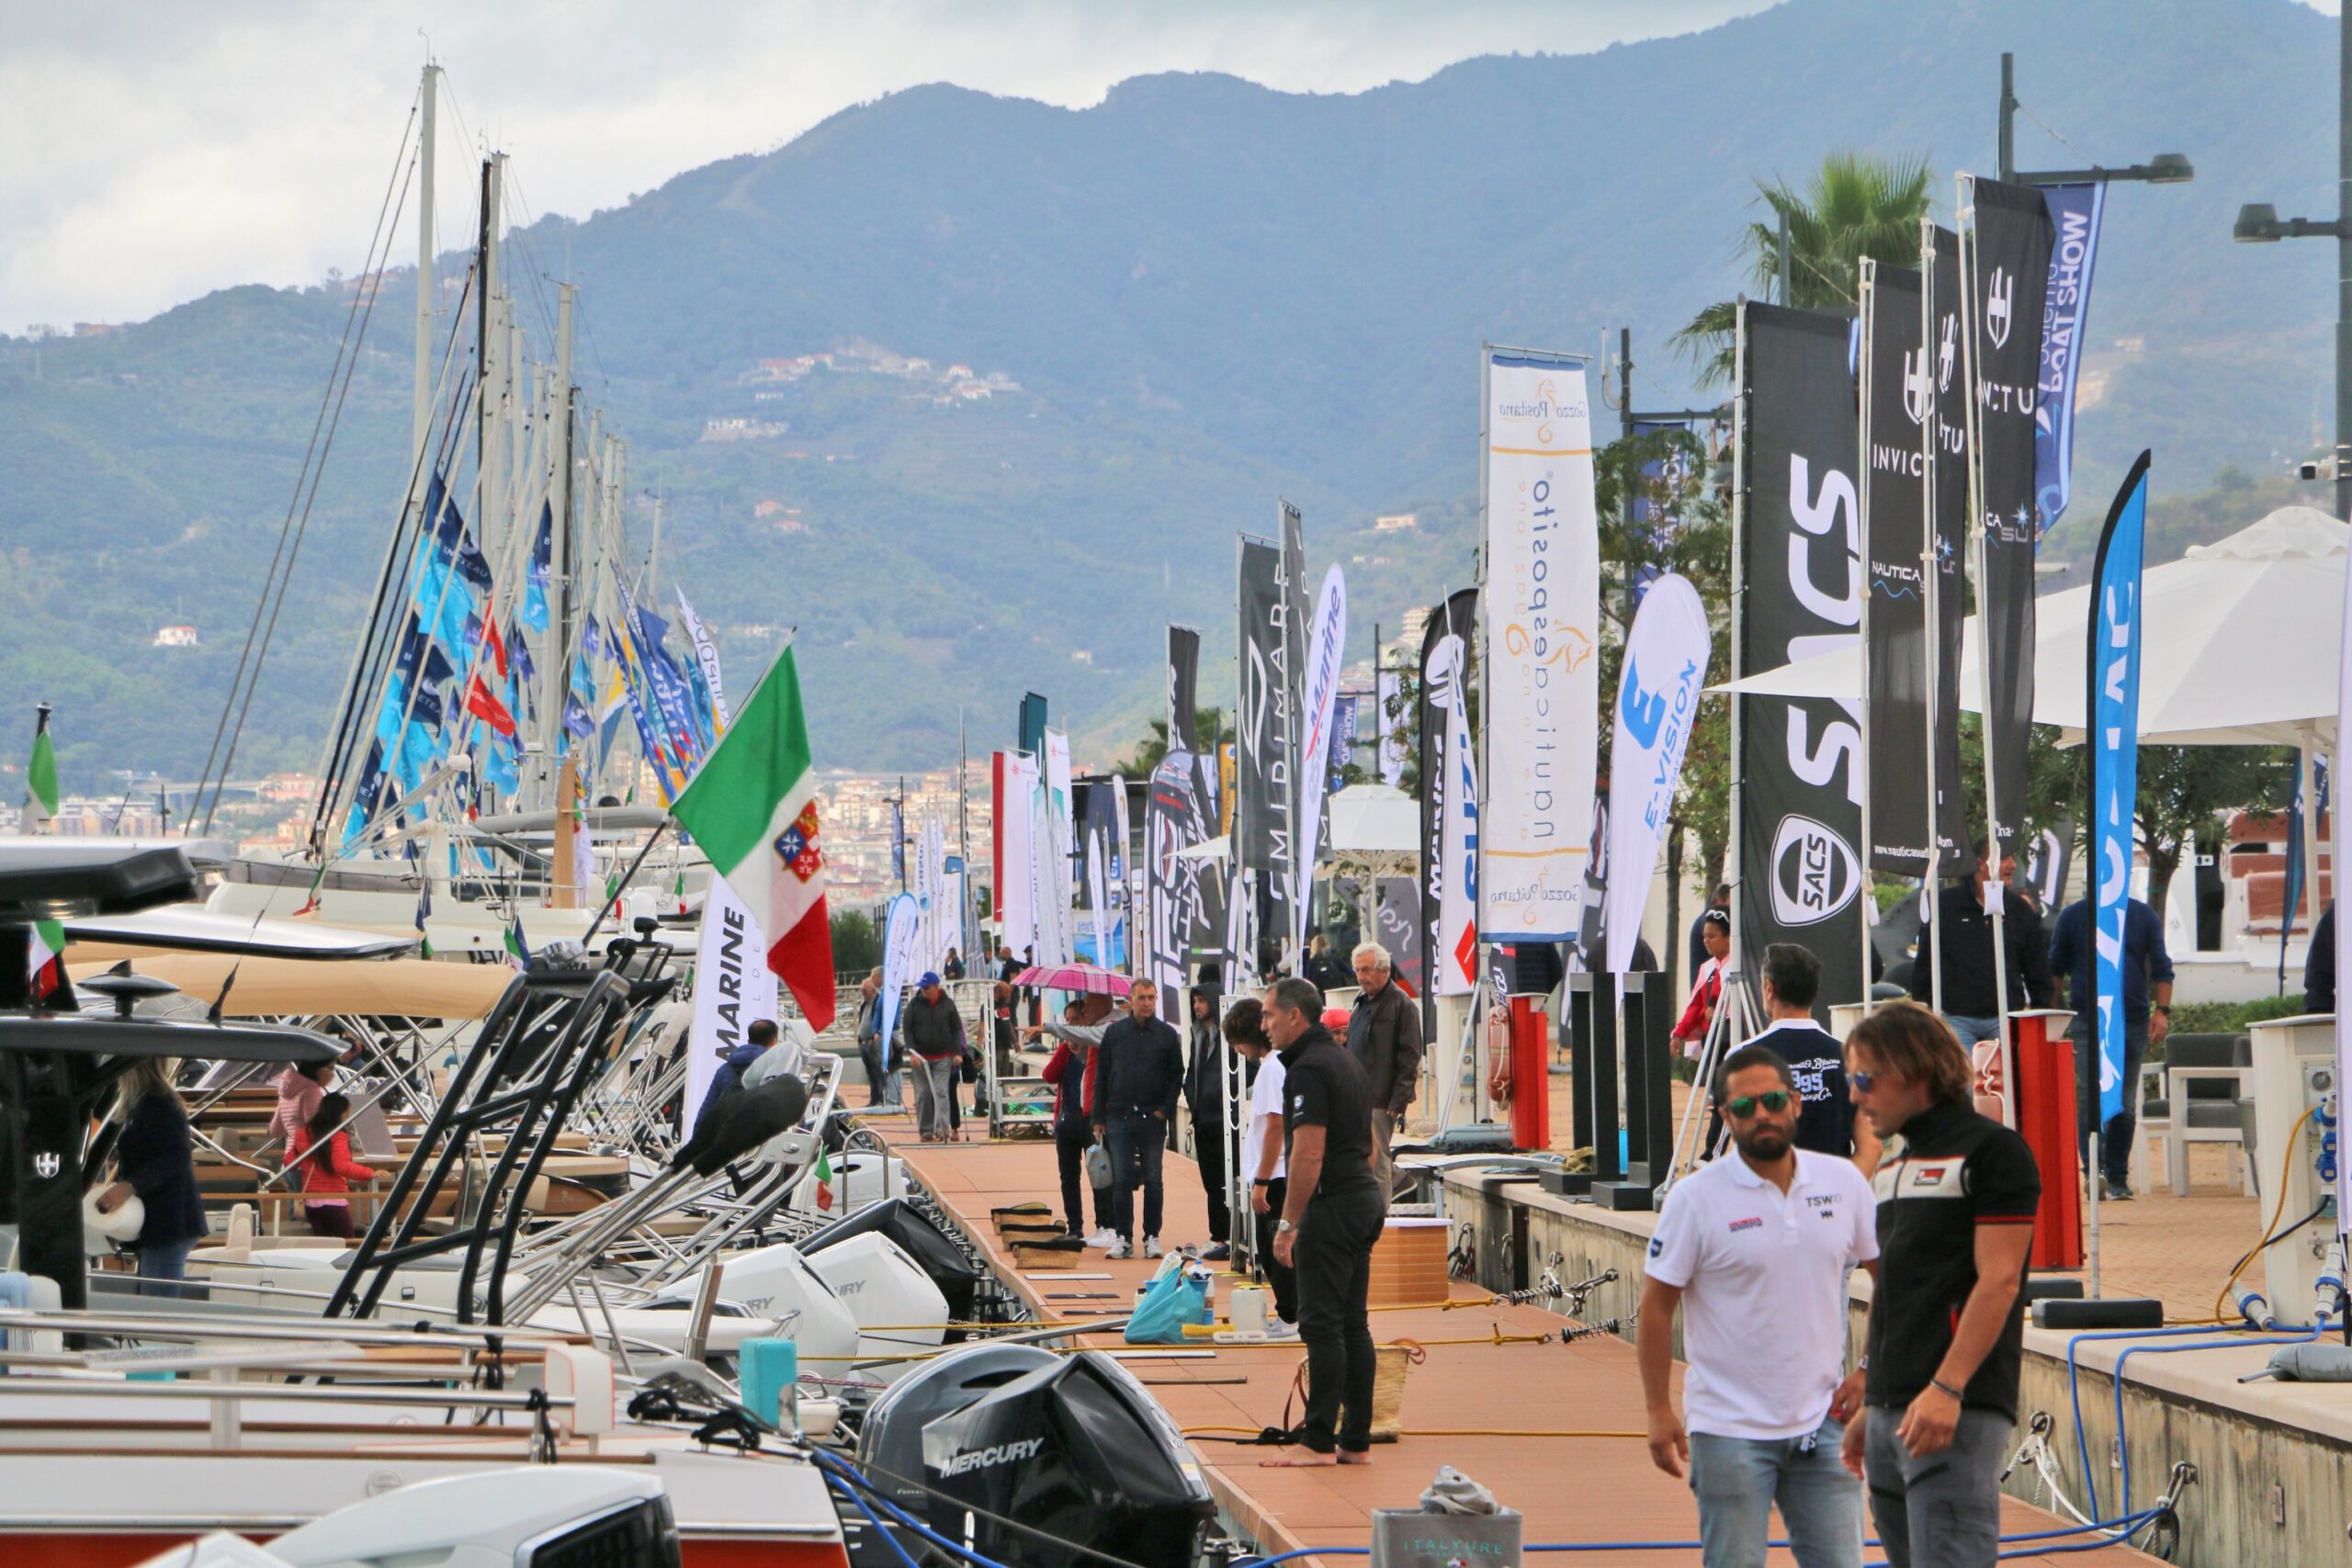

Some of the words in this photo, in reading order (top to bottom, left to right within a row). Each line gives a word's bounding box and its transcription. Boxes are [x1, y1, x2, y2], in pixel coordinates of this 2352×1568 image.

[2057, 211, 2088, 306] SHOW
[1872, 560, 1921, 581] NAUTICA
[1645, 658, 1698, 832] E-VISION
[1804, 833, 1827, 912] SACS
[715, 906, 745, 1063] MARINE
[941, 1438, 1045, 1479] MERCURY
